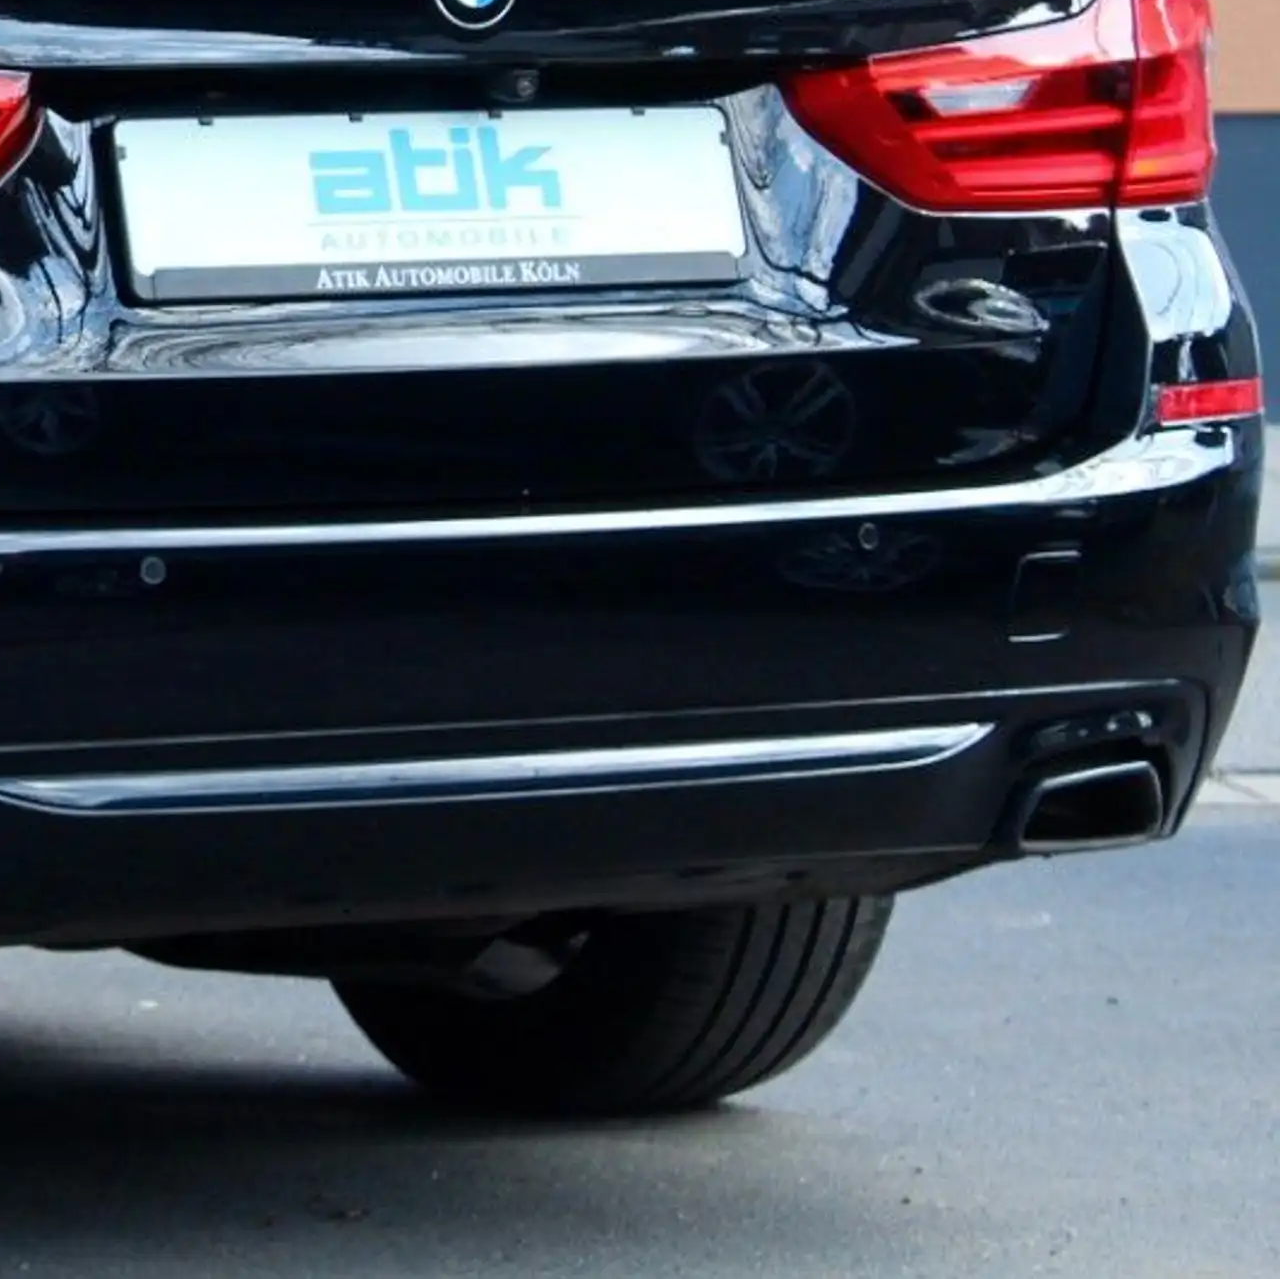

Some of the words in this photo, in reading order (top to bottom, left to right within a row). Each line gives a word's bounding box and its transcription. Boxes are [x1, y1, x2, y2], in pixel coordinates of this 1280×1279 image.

[309, 125, 561, 214] atik
[316, 266, 370, 290] ATIK
[374, 264, 516, 287] AUTOMOBILE
